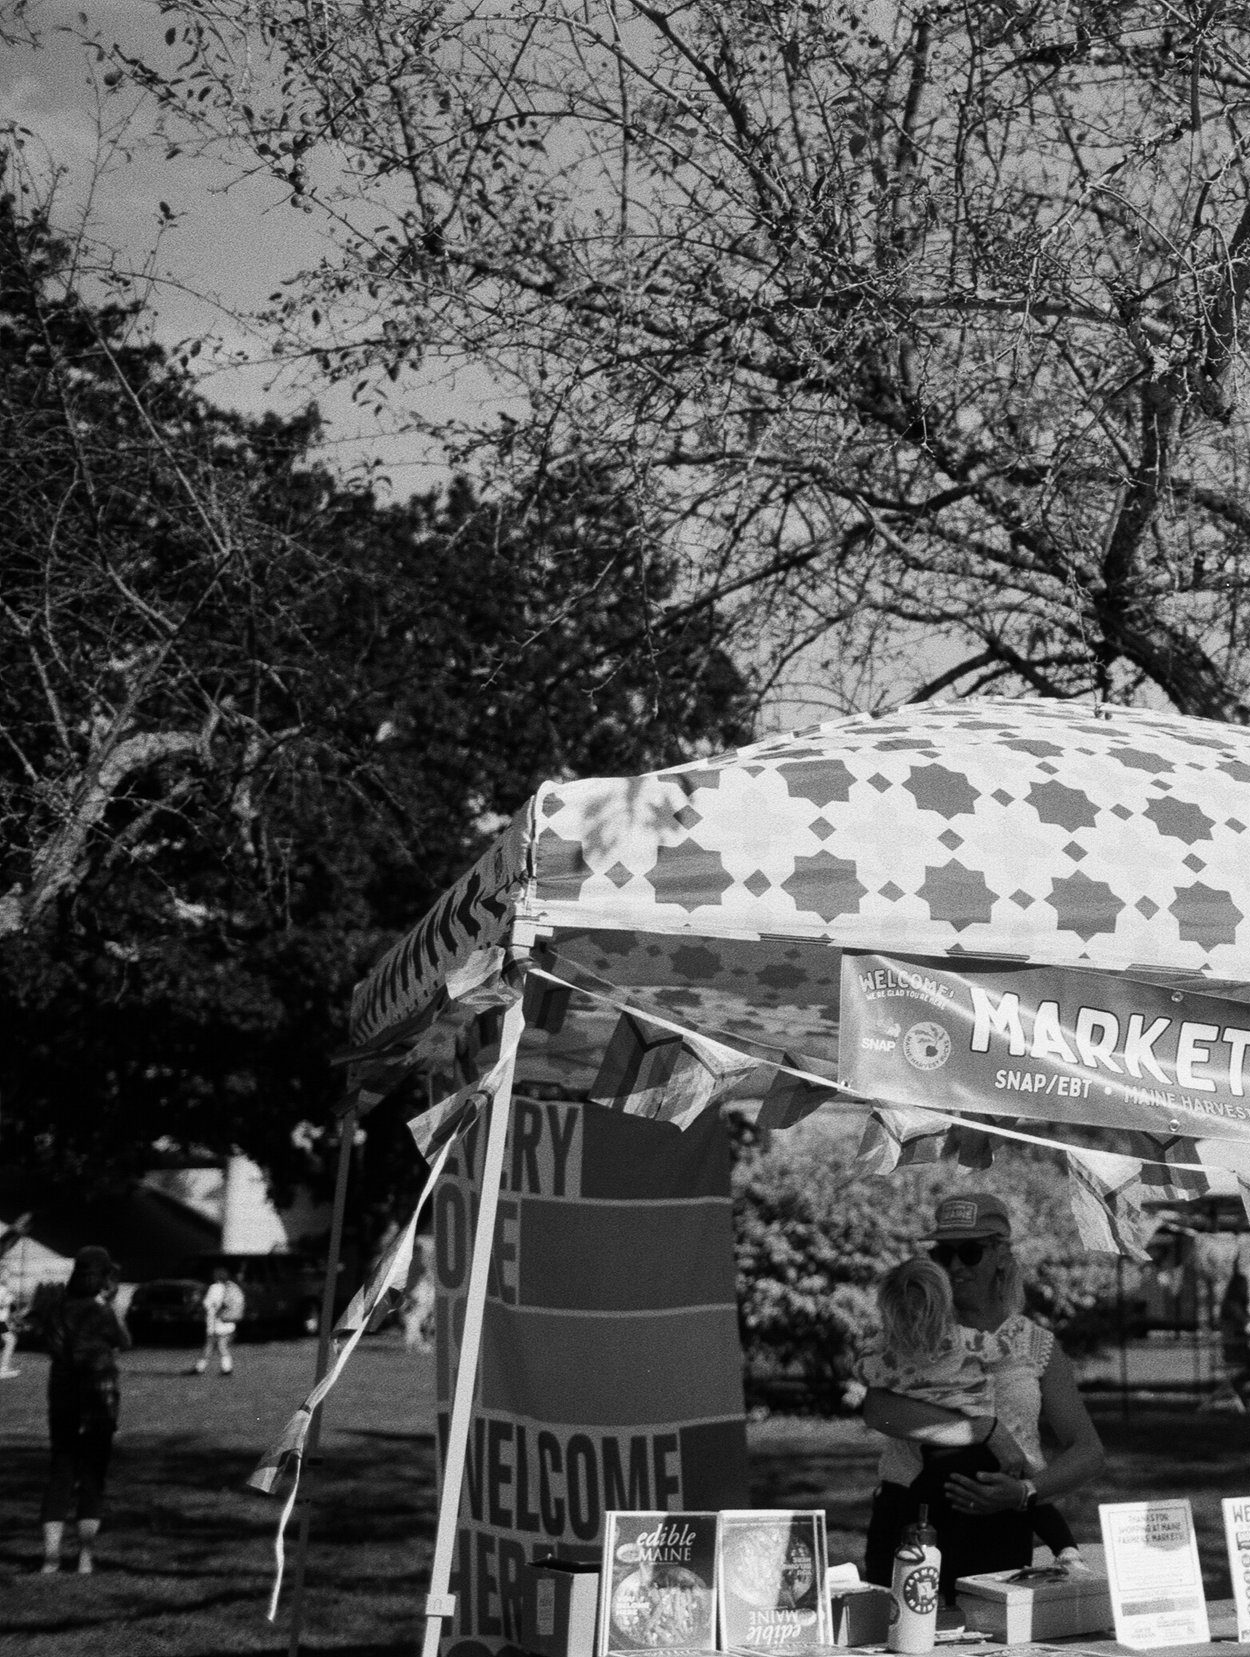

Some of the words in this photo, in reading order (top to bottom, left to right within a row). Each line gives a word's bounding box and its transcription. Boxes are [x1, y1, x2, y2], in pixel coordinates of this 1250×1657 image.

[858, 969, 955, 998] WELCOME!
[887, 988, 905, 998] GLAD
[861, 1037, 897, 1052] SNAP
[993, 1067, 1093, 1100] SNAP/EBT
[1123, 1084, 1178, 1110] MAINE
[436, 1182, 517, 1304] OE
[437, 1411, 681, 1541] WELCOME
[636, 1523, 697, 1546] edible
[639, 1547, 692, 1562] MAINE
[749, 1610, 800, 1626] MAINE
[746, 1624, 802, 1646] edible
